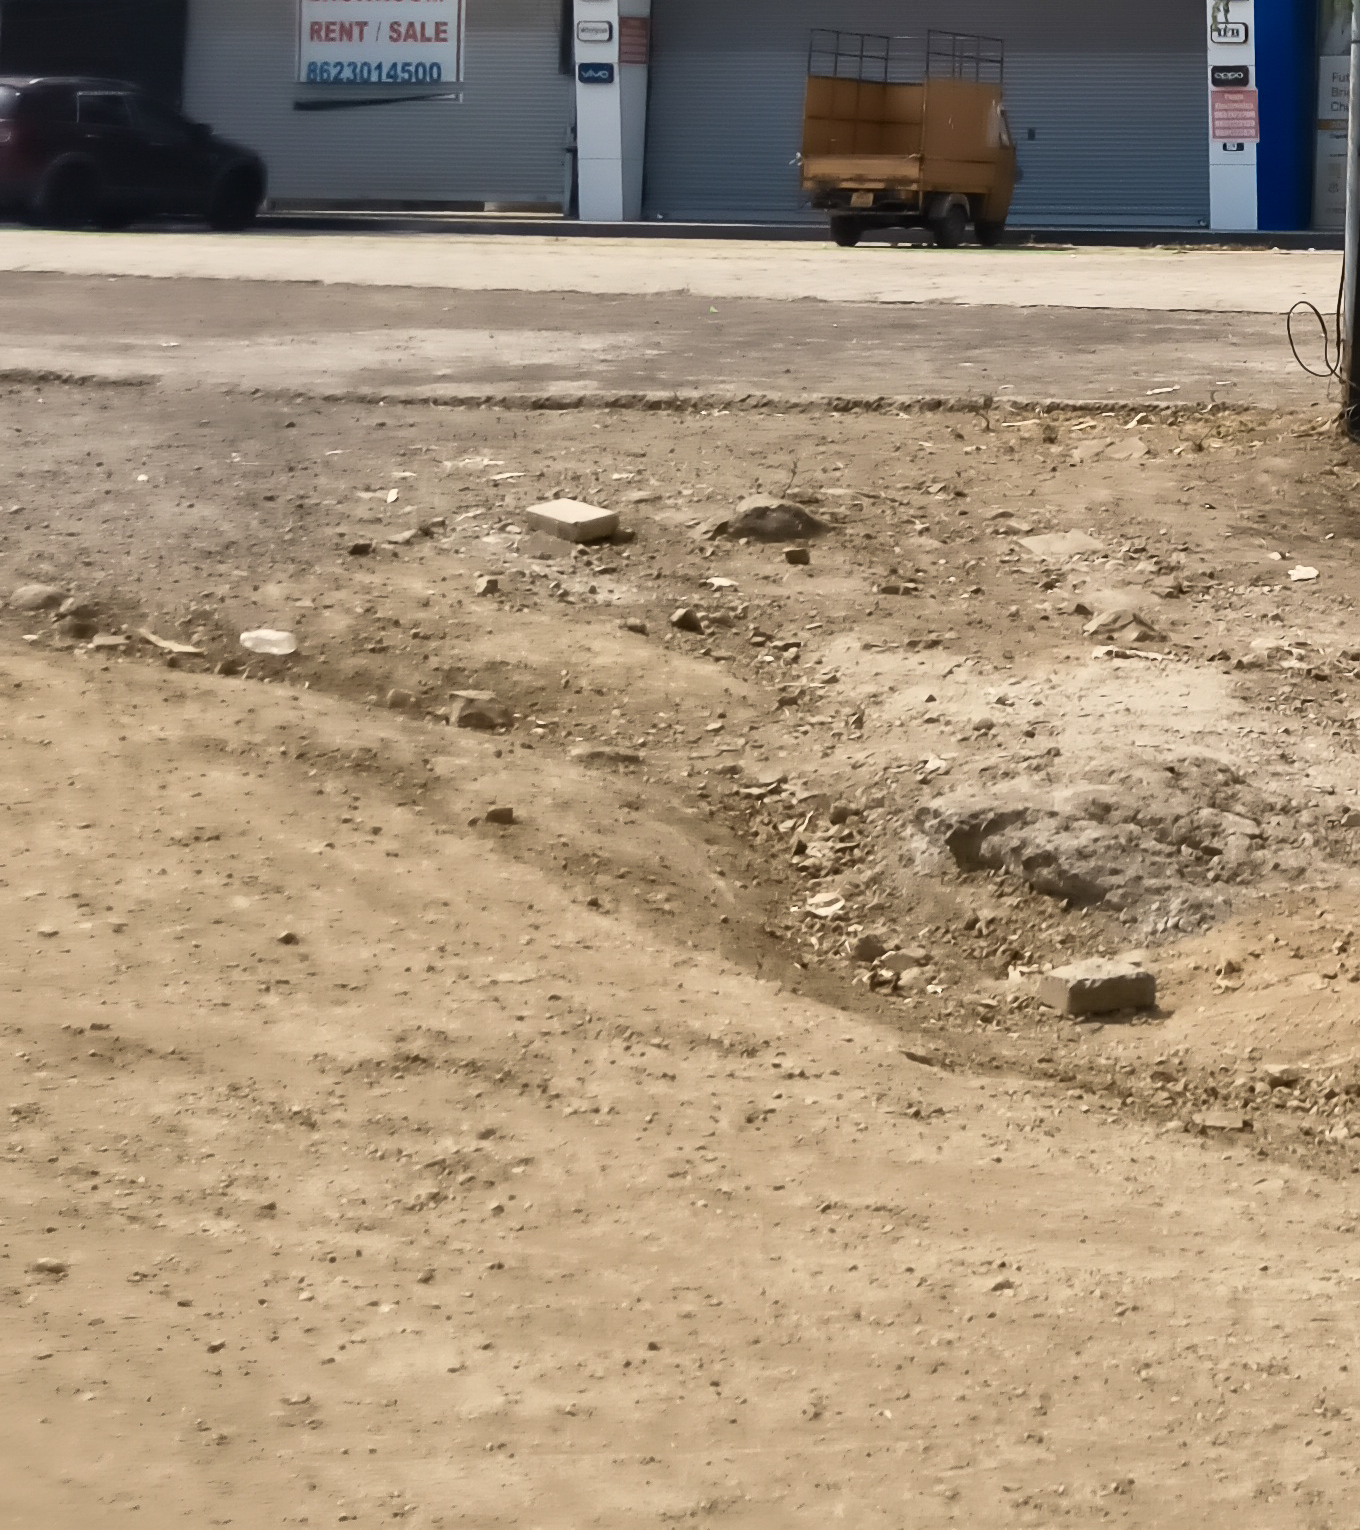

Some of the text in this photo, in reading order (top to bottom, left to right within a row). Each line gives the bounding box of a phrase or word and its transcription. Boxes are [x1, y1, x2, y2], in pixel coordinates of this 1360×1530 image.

[309, 21, 370, 43] RENT
[388, 21, 449, 43] SALE
[306, 60, 443, 83] 8623014500
